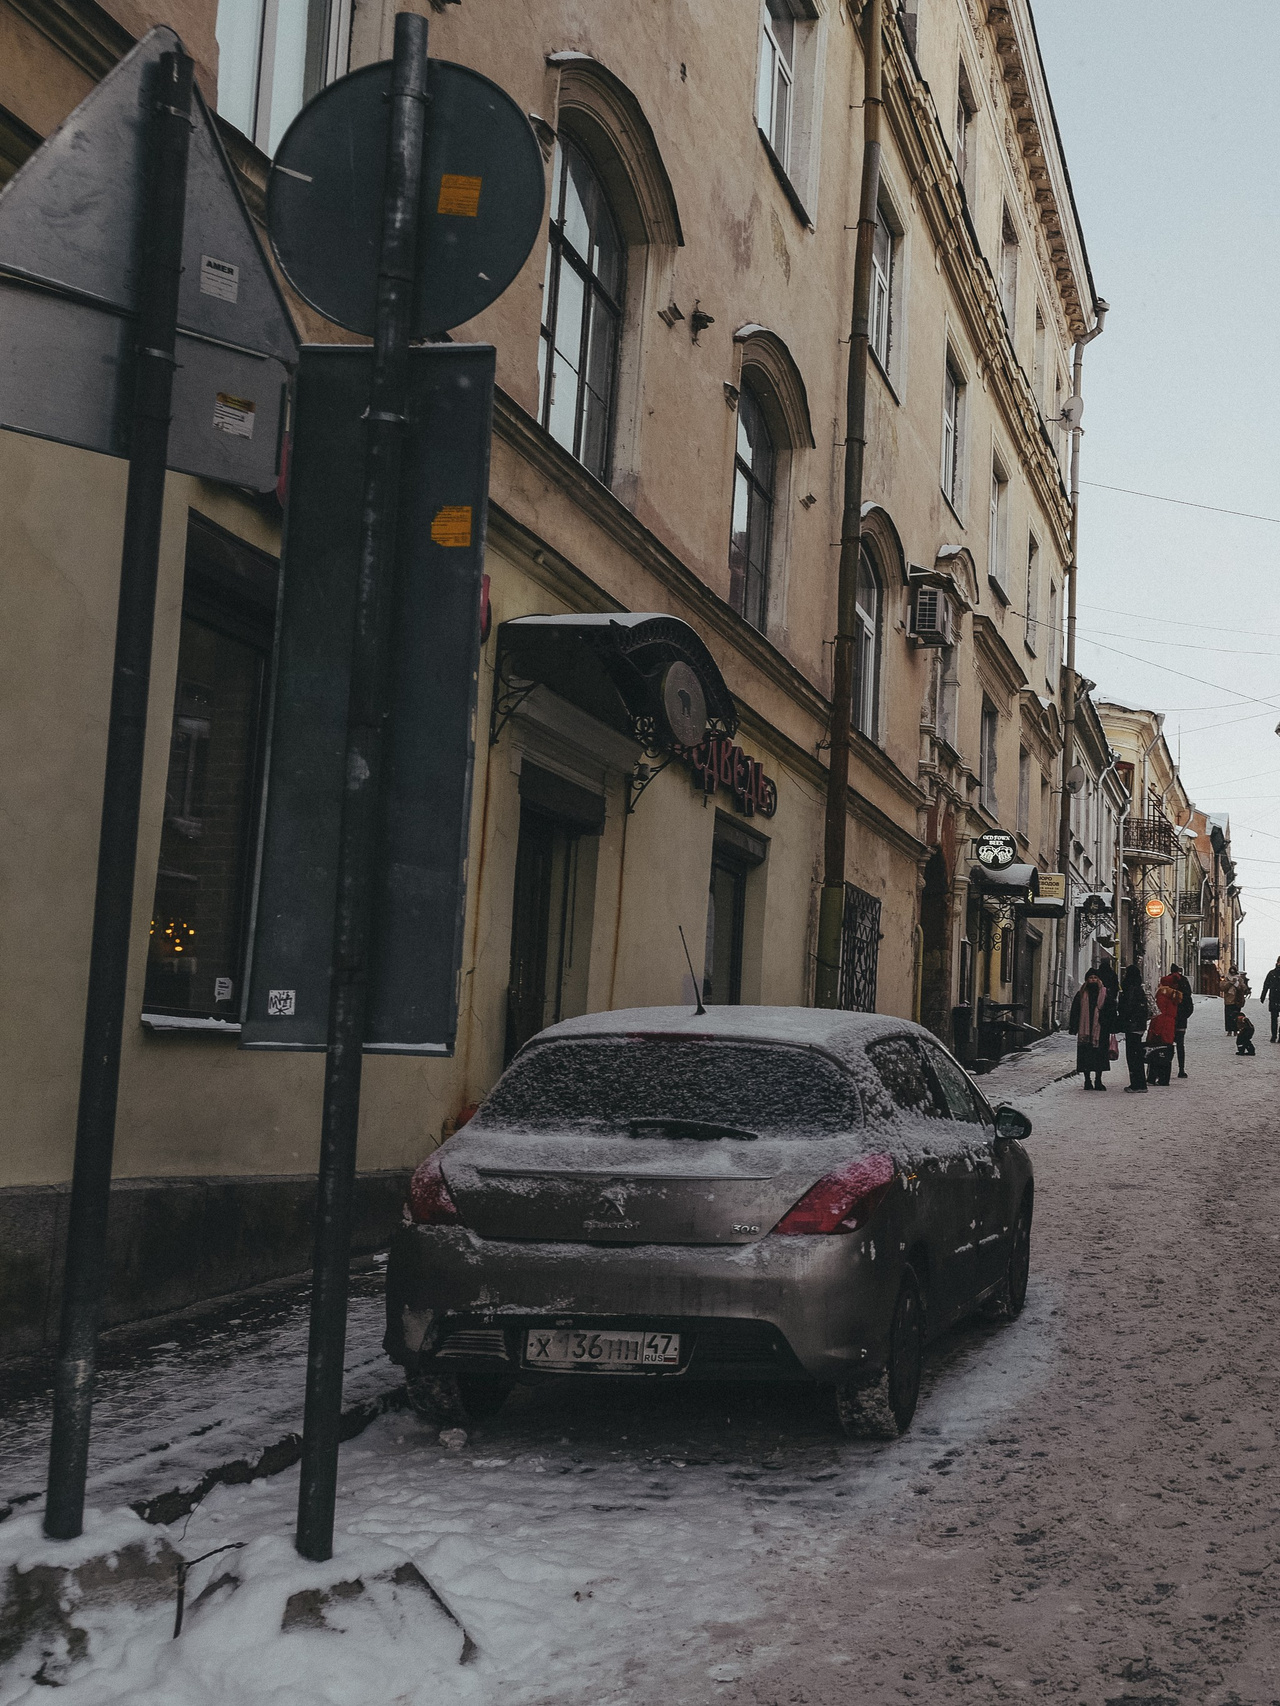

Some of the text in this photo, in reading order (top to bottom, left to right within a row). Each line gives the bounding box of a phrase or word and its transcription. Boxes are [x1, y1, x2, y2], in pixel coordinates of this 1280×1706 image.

[674, 733, 773, 817] ДВЕДЬ
[731, 1223, 760, 1234] 308
[646, 1334, 673, 1354] 47
[644, 1354, 663, 1362] RUS
